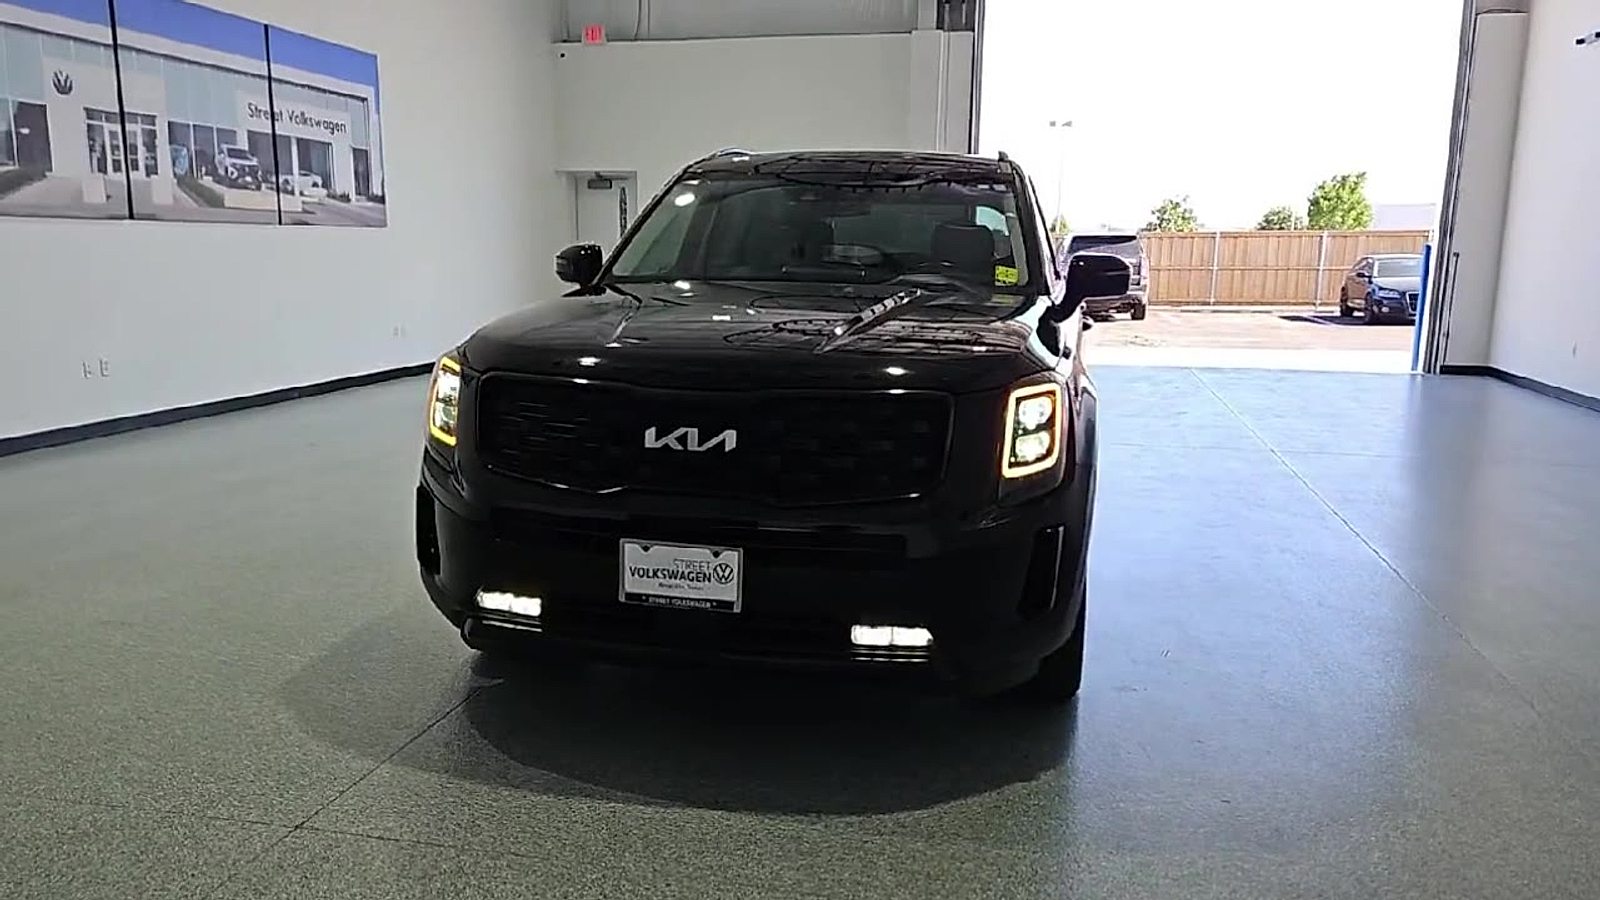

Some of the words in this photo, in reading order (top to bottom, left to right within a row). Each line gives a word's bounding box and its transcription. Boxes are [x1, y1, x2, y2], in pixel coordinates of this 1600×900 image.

[287, 110, 347, 136] Volkswagen
[645, 426, 736, 452] KIA
[629, 566, 712, 583] VOLKSWAGEN
[674, 559, 712, 571] STREET
